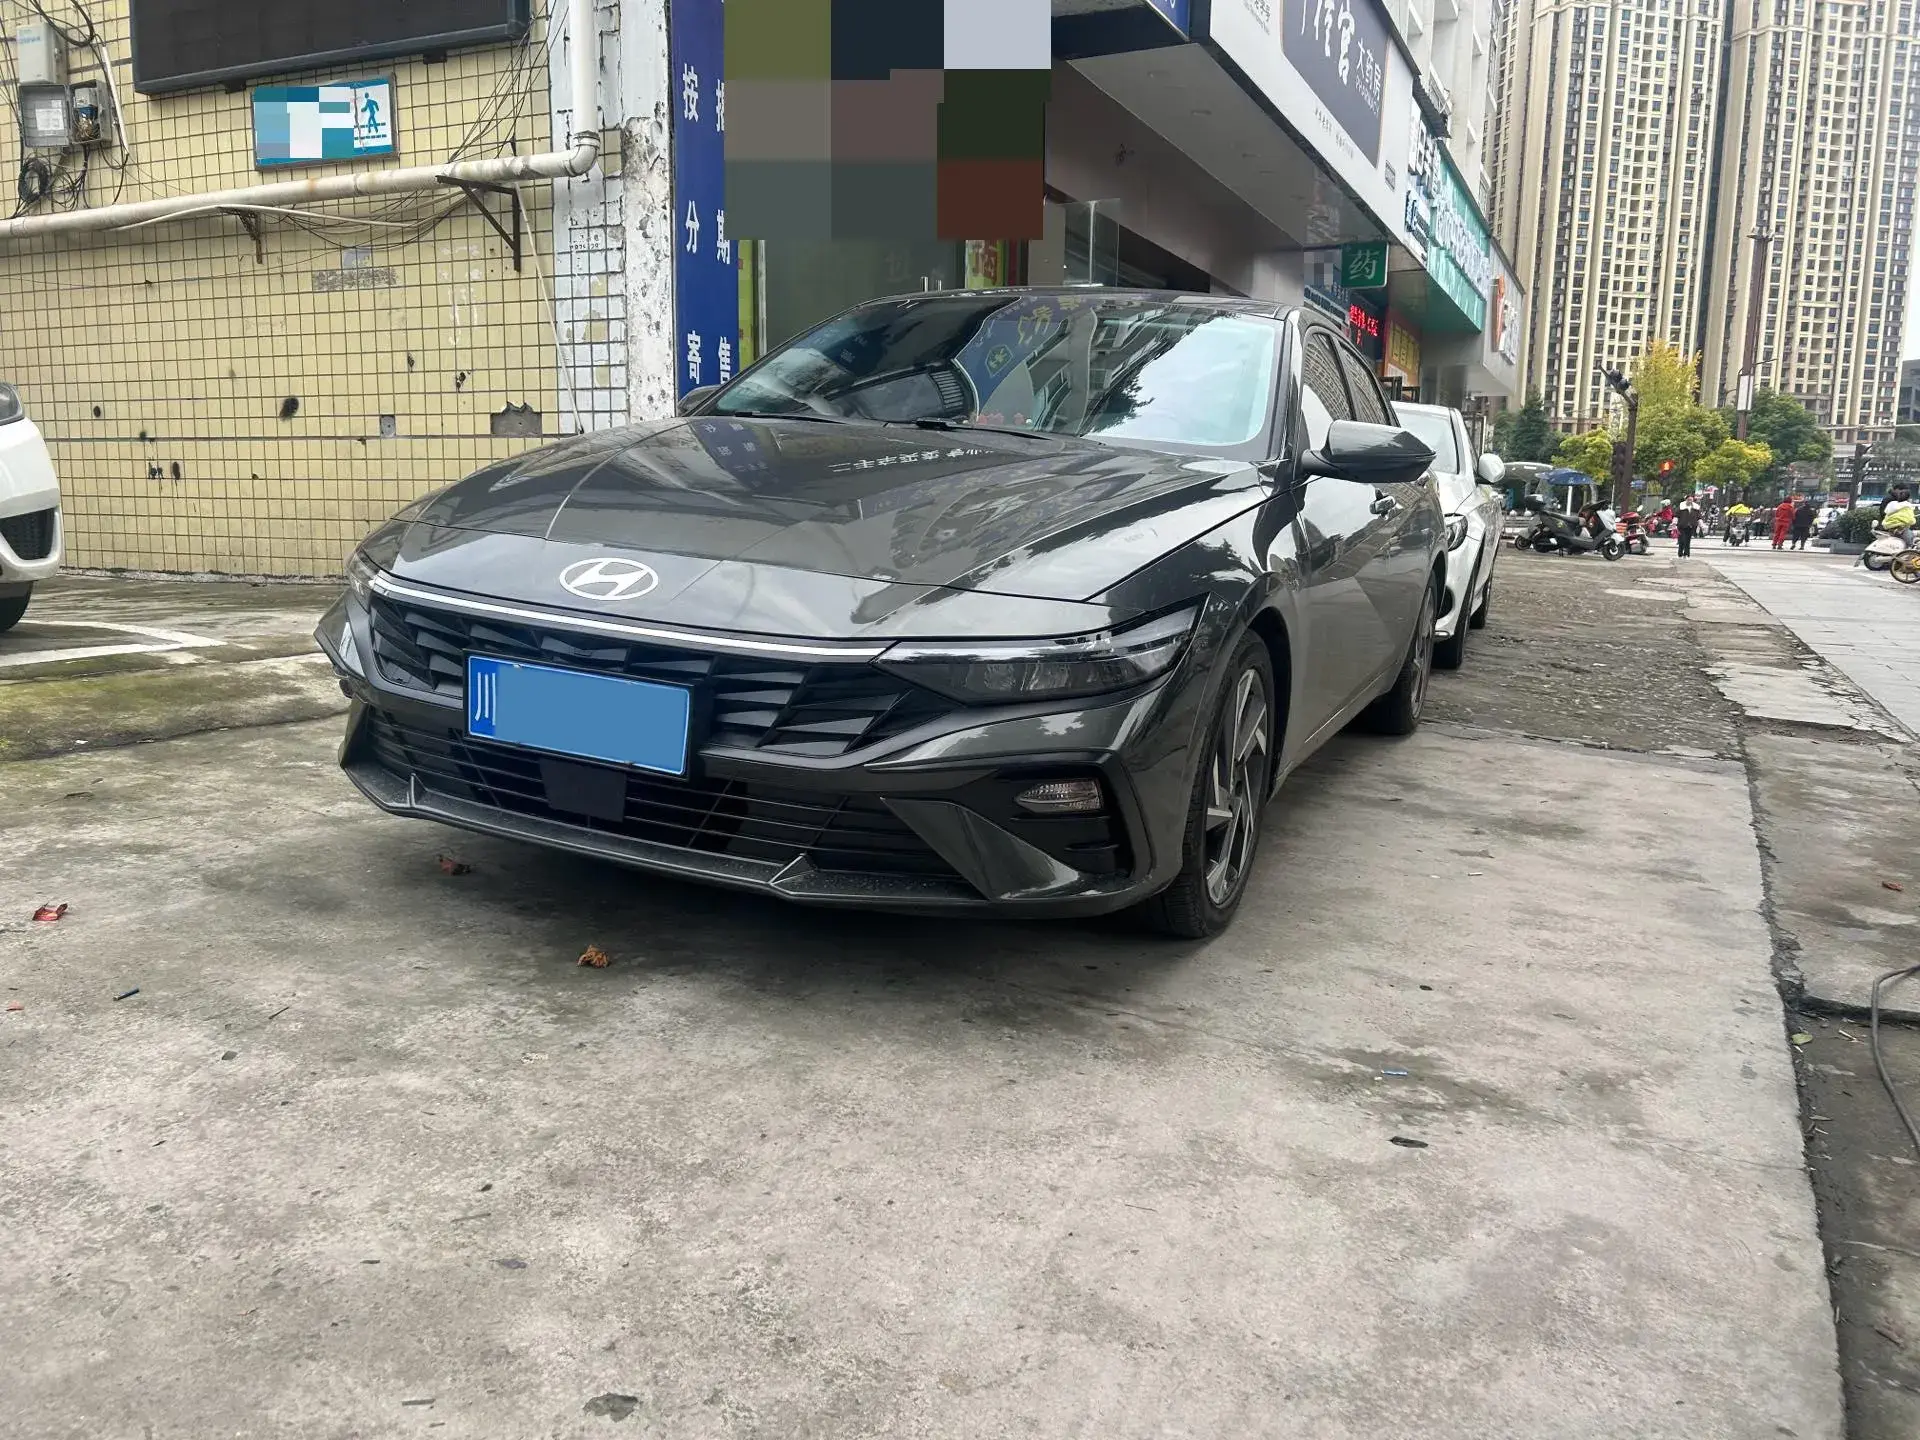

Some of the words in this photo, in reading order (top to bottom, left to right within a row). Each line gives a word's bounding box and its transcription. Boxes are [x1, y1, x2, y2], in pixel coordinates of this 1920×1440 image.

[1356, 37, 1382, 100] 大药房
[1349, 250, 1380, 280] 药
[474, 671, 496, 726] 川
